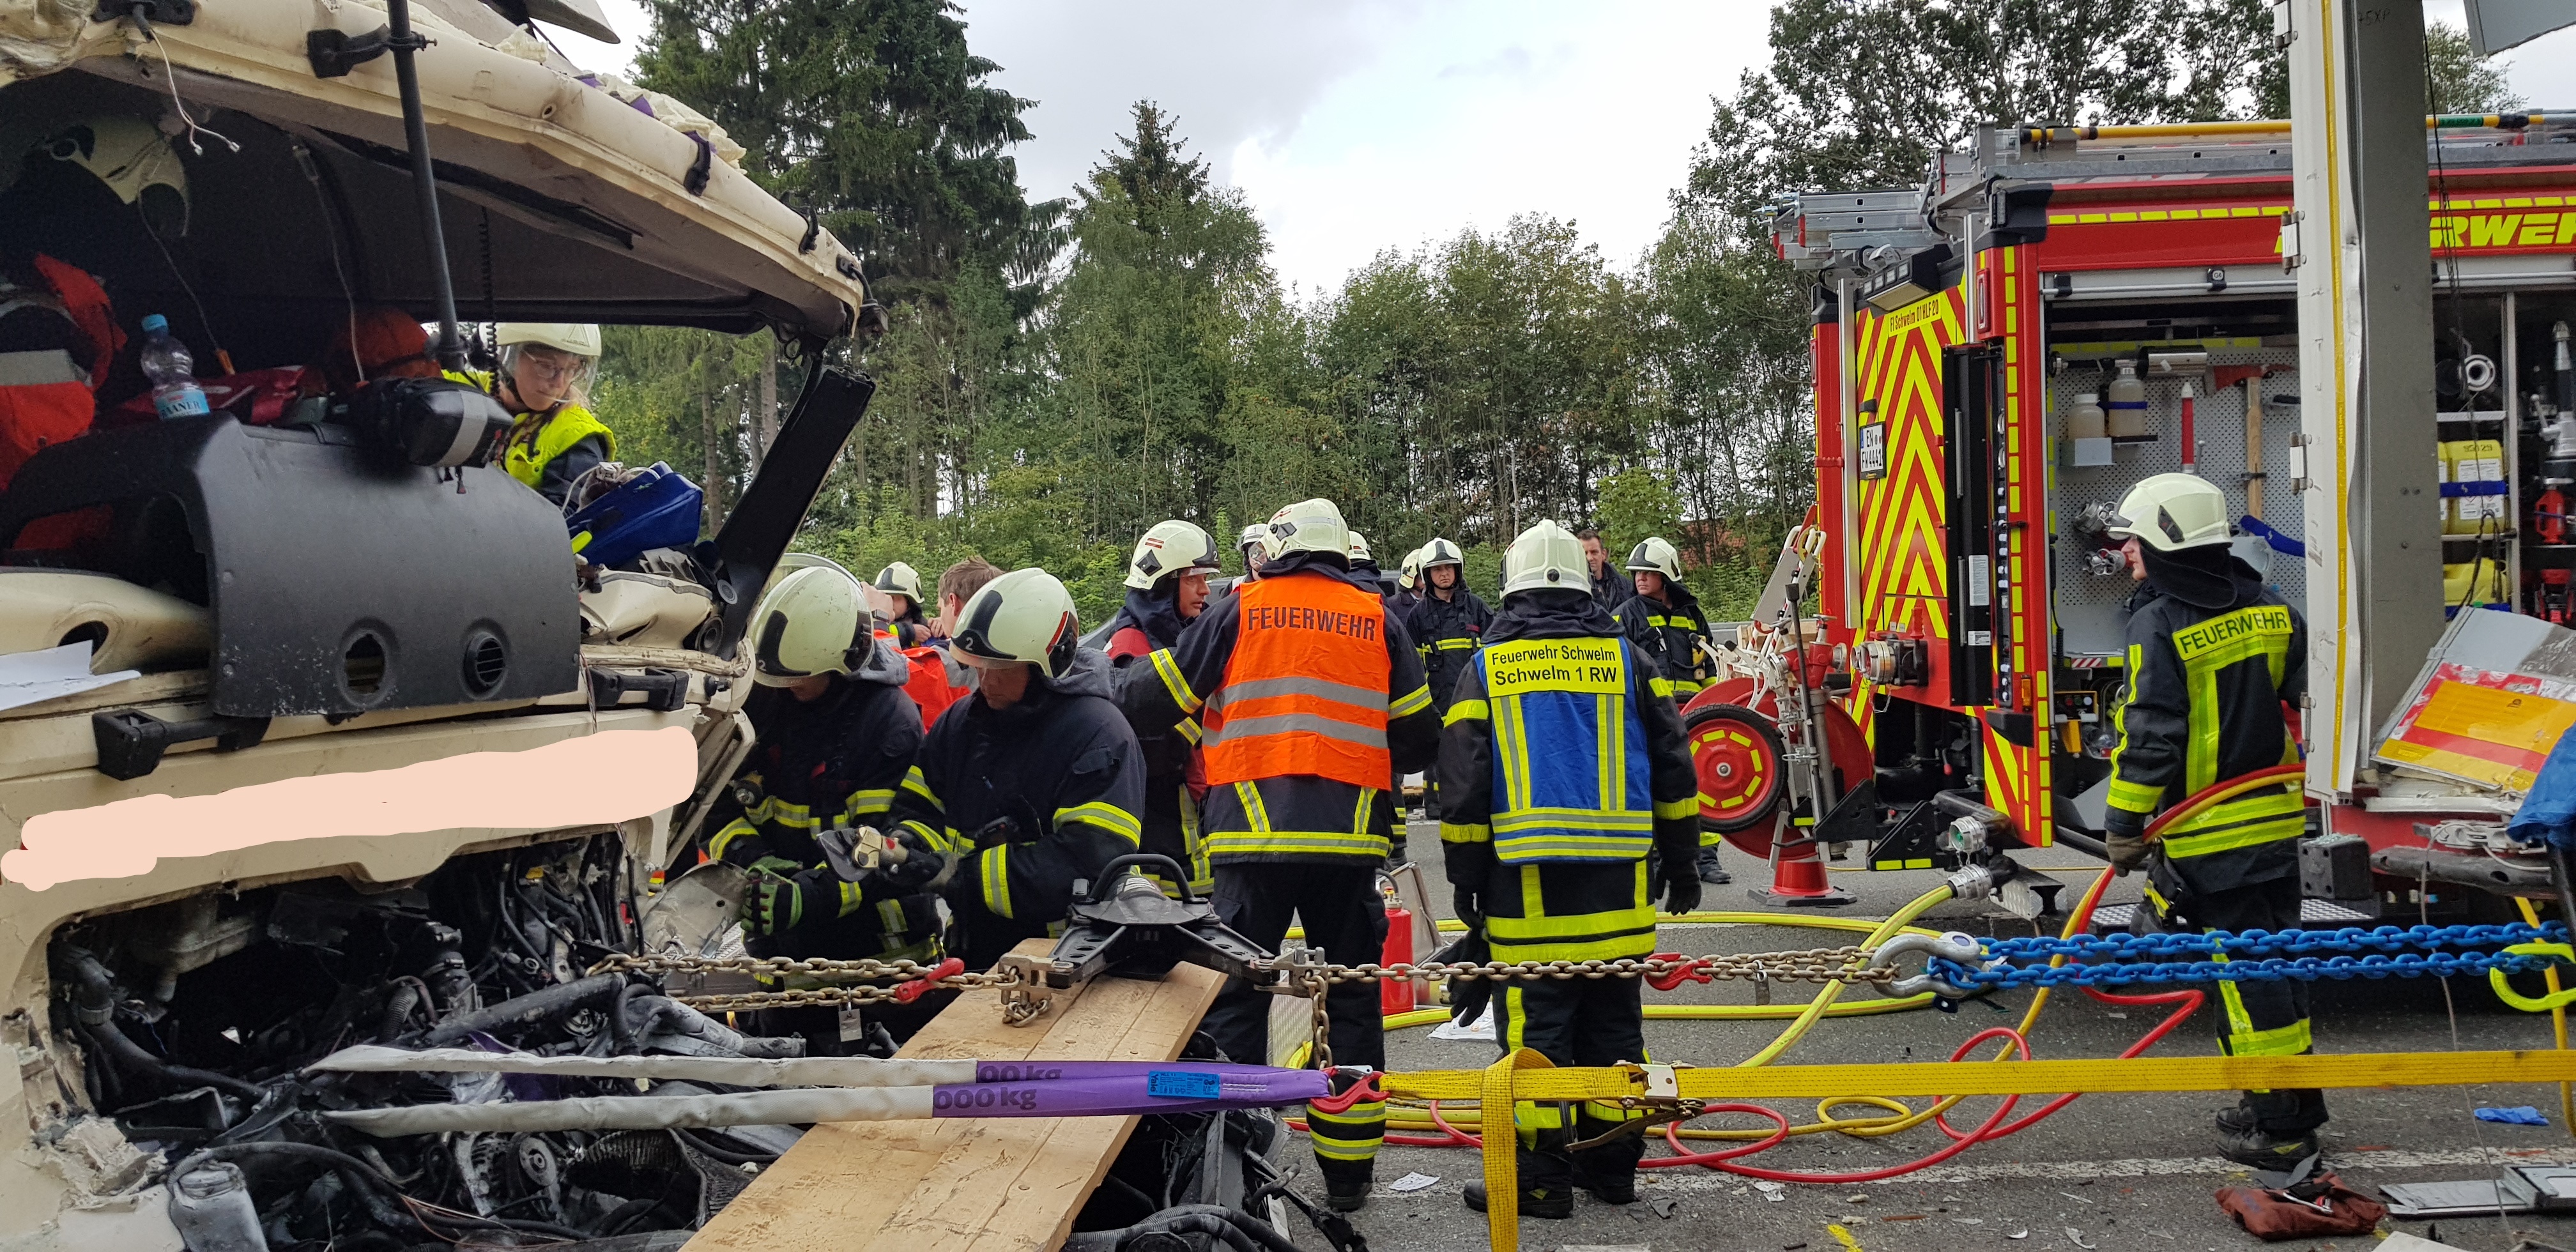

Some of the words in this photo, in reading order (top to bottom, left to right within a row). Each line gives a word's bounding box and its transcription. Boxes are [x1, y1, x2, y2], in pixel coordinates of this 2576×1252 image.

[1895, 310, 1915, 330] Schwelm
[1866, 429, 1873, 447] EN
[1213, 551, 1218, 561] 2
[1248, 607, 1376, 641] FEUERWEHR
[2179, 611, 2287, 653] FEUERWEHR
[965, 637, 974, 651] 2
[1492, 645, 1558, 665] Feuerwehr
[1561, 645, 1616, 661] Schwelm
[758, 660, 767, 671] 2
[1495, 665, 1570, 685] Schwelm
[1575, 666, 1583, 681] 1
[1590, 667, 1617, 682] RW
[1150, 1074, 1158, 1092] Yale
[1000, 1087, 1037, 1110] kg
